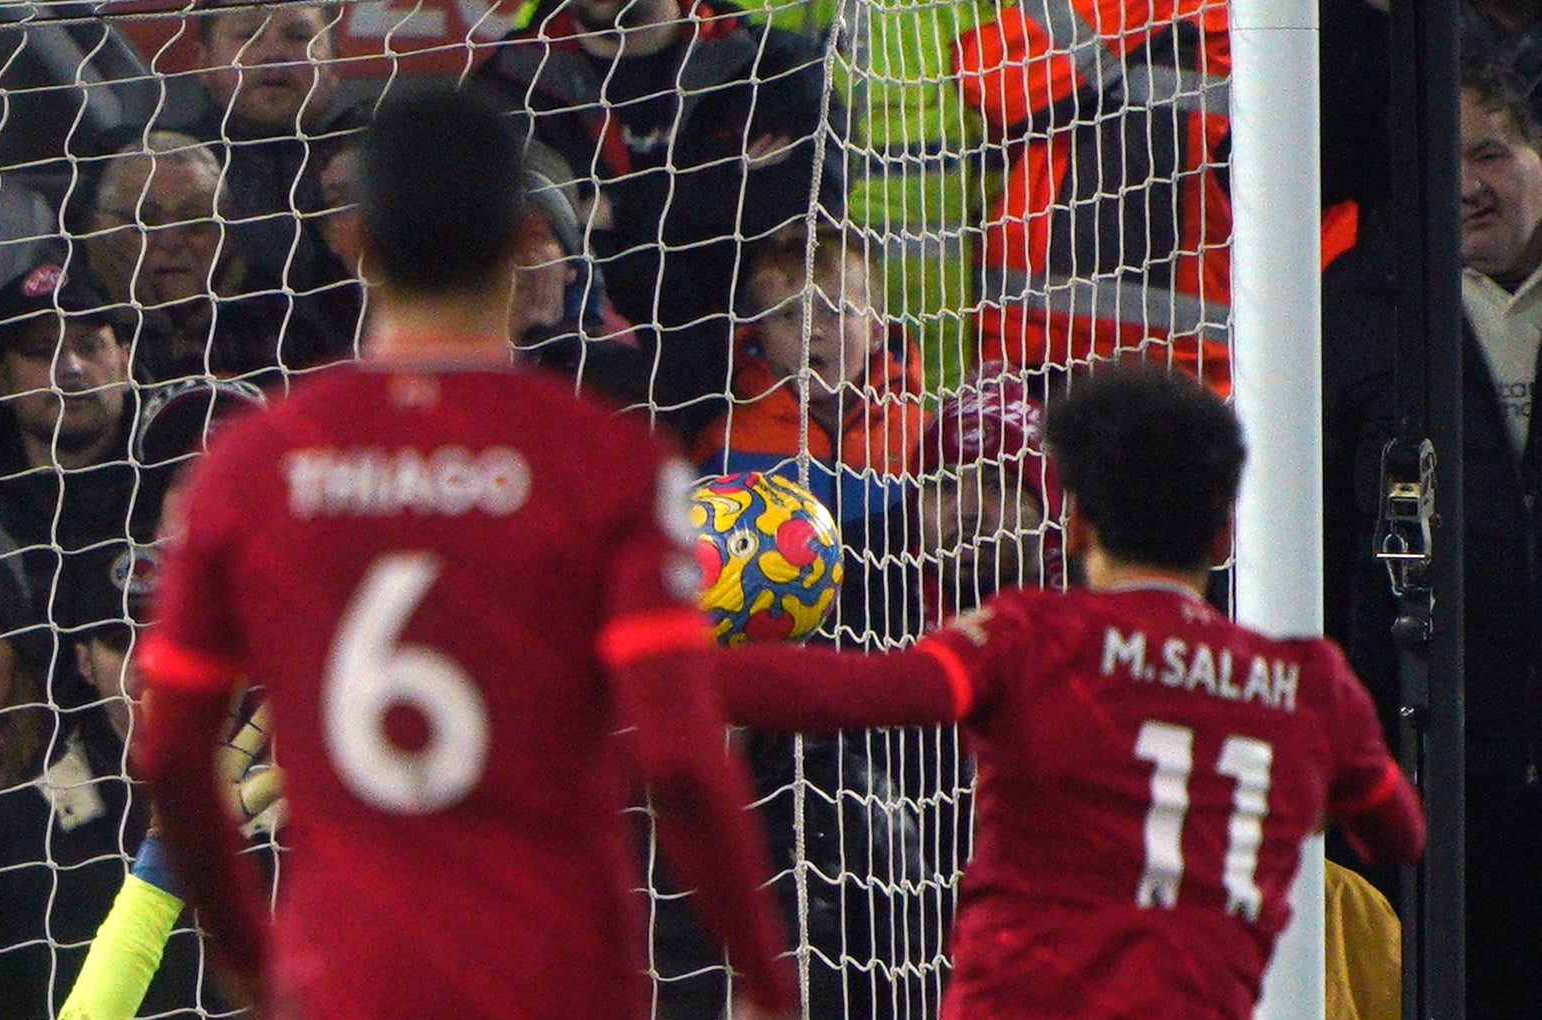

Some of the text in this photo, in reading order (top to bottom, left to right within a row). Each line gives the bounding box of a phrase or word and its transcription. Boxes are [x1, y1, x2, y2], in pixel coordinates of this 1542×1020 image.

[288, 449, 531, 515] THIAGO
[323, 555, 487, 811] 6
[1103, 627, 1299, 711] M.SALAH
[1134, 719, 1275, 924] 11
